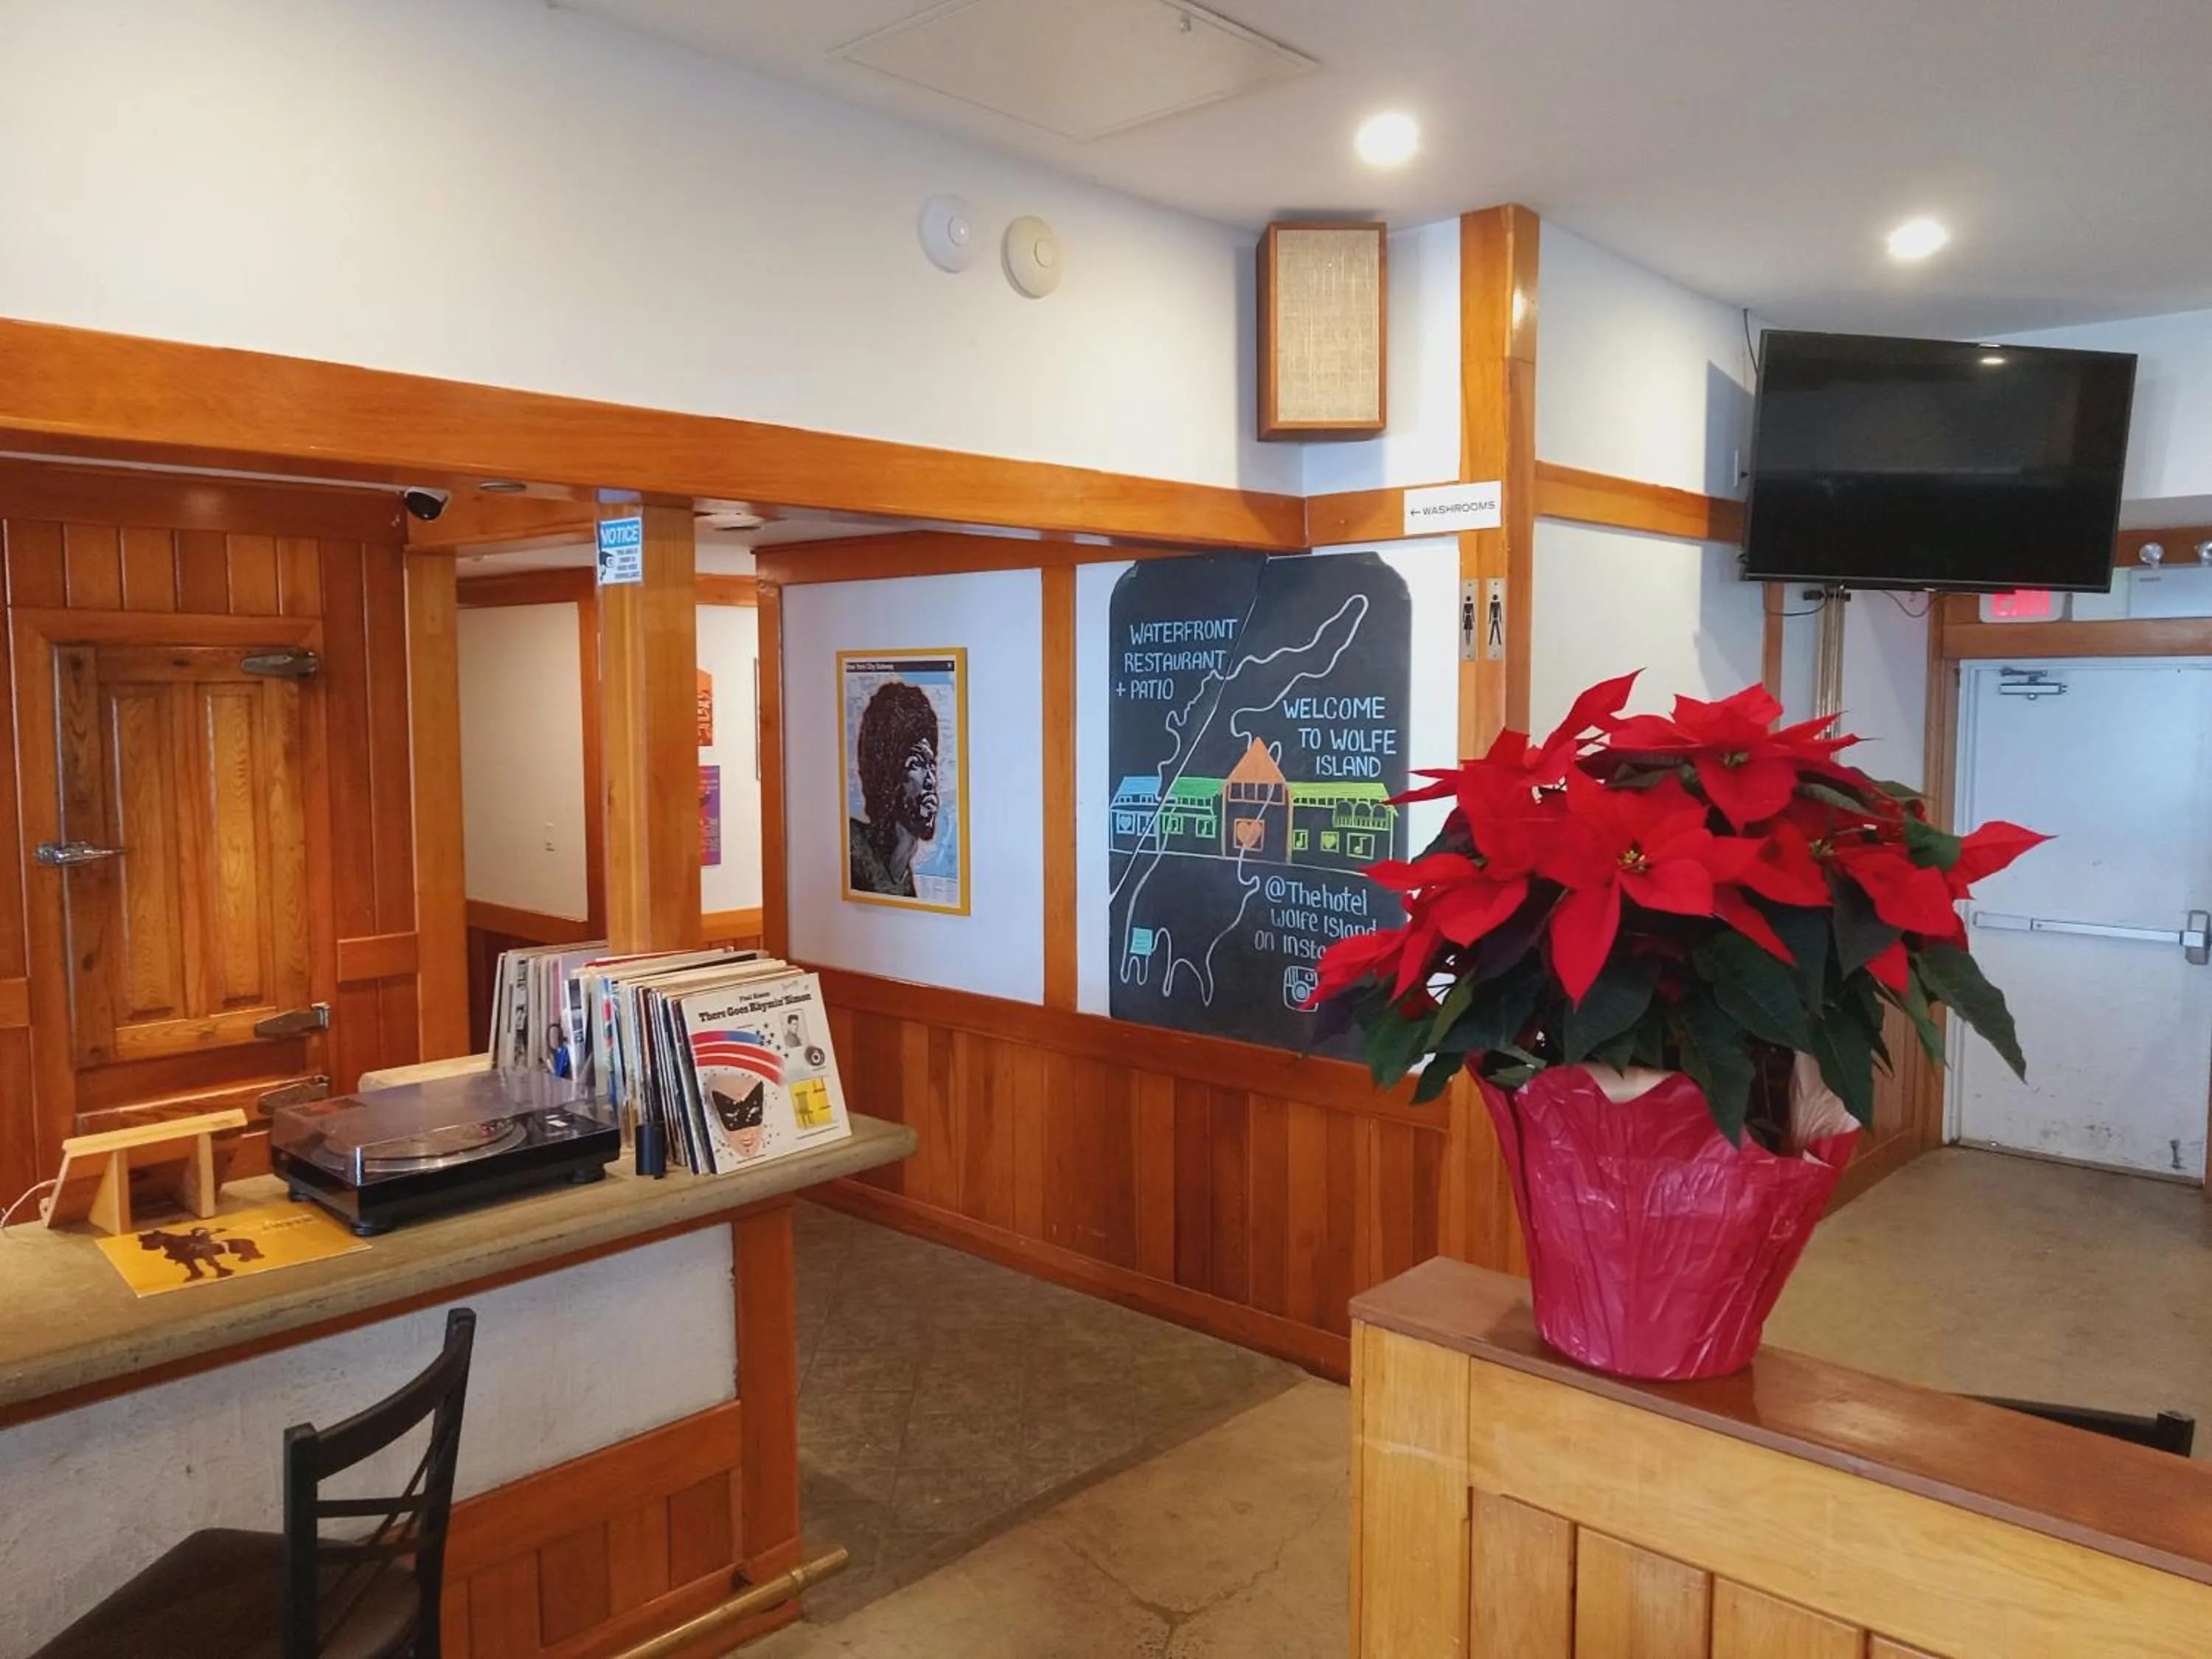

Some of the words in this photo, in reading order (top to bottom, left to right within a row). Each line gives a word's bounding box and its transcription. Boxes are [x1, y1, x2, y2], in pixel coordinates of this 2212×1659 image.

[1422, 501, 1496, 515] WASHROOMS
[600, 524, 639, 544] NOTICE
[1130, 619, 1238, 645] WATERFRONT
[1124, 650, 1226, 673] RESTAURANT
[1130, 678, 1175, 700] PATIO
[1283, 697, 1386, 720] WELCOME
[1298, 728, 1321, 750] TO
[1330, 729, 1397, 755] WOLFE
[1315, 755, 1381, 778] ISLAND
[1265, 875, 1368, 916] @Thehotel
[698, 1010, 726, 1023] There
[726, 1006, 749, 1017] Goes
